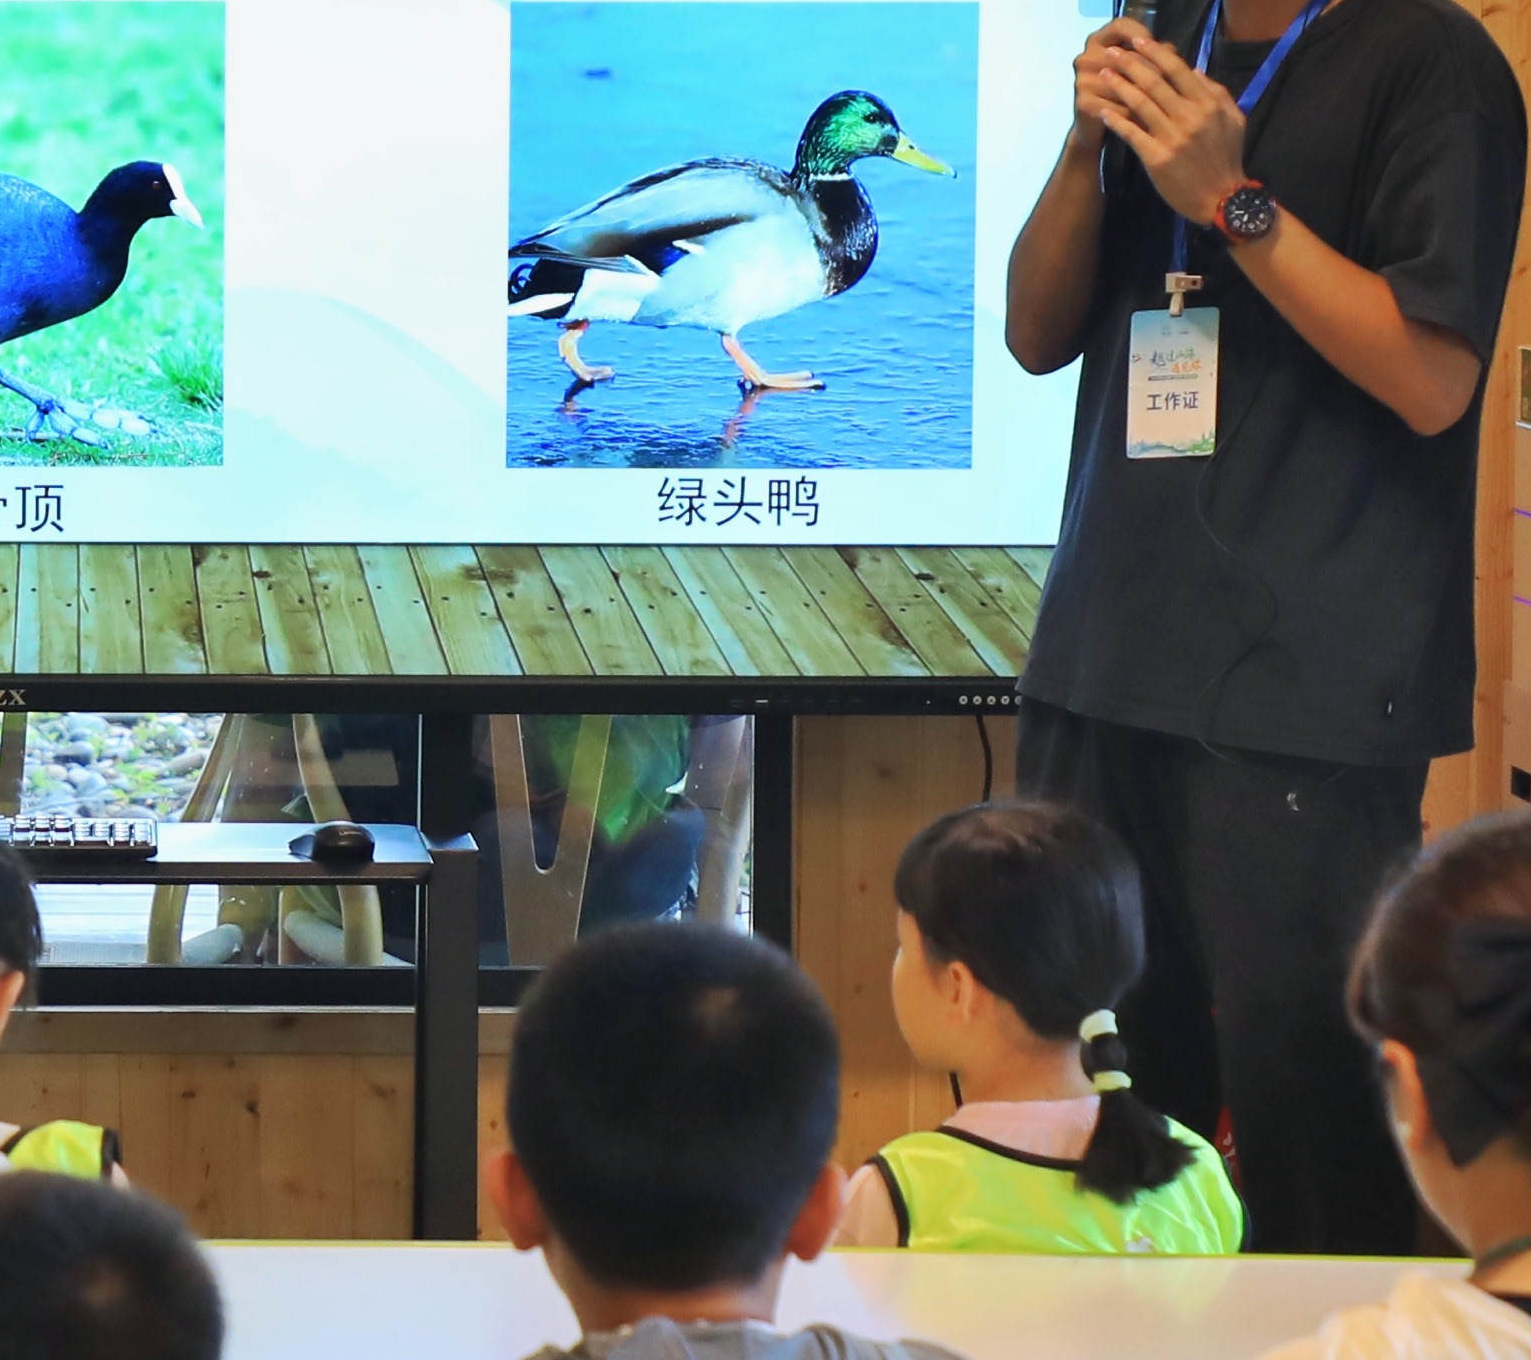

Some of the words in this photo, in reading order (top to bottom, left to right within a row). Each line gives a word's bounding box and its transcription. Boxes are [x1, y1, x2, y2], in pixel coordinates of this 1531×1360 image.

[1146, 391, 1199, 411] 工作证
[656, 475, 820, 526] 绿头鸭
